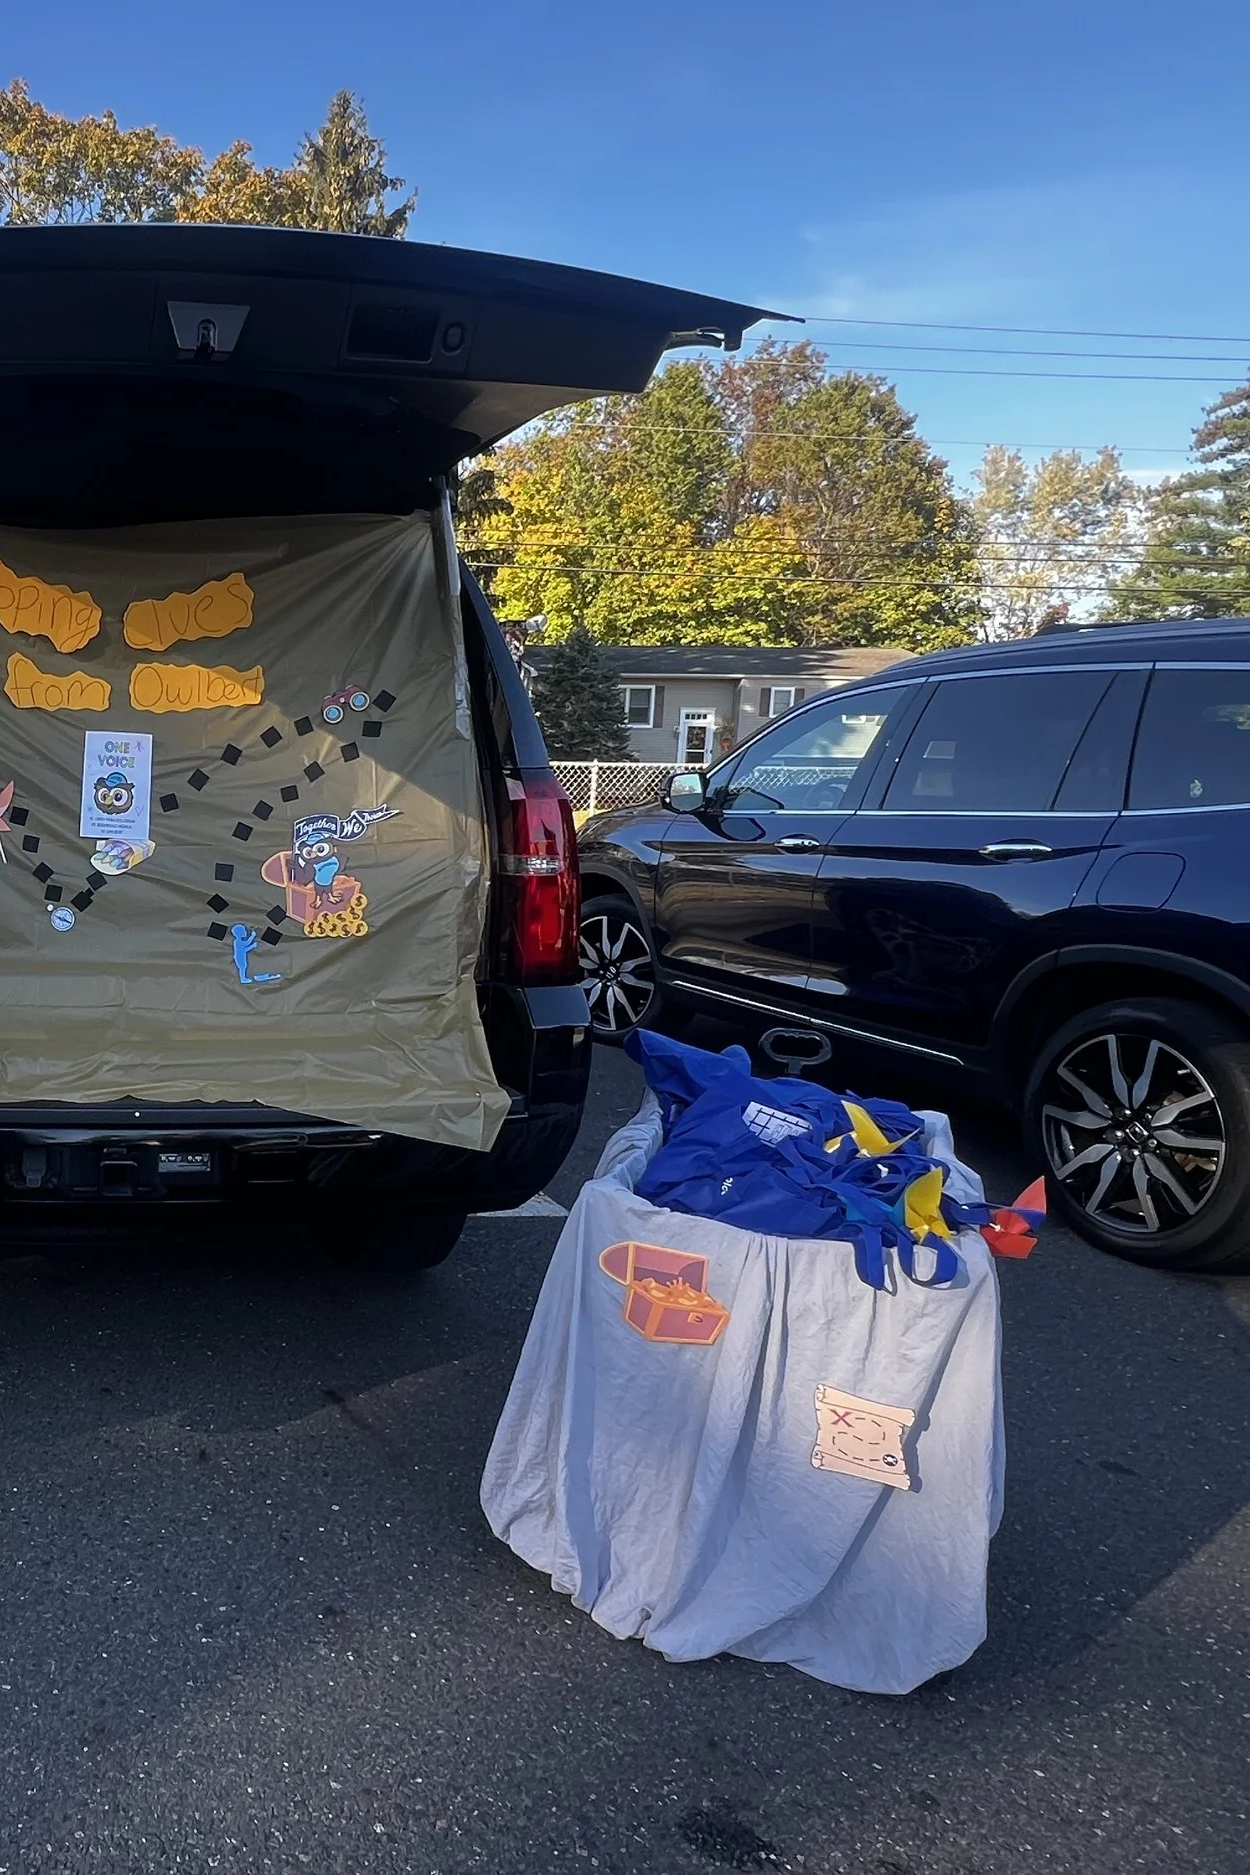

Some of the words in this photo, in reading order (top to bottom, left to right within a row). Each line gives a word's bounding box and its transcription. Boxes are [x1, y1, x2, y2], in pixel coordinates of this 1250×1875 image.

[10, 659, 105, 706] from
[133, 666, 260, 707] Owlbert
[104, 740, 130, 754] ONE
[97, 754, 135, 768] VOICE
[296, 818, 336, 835] Together
[340, 819, 362, 837] We
